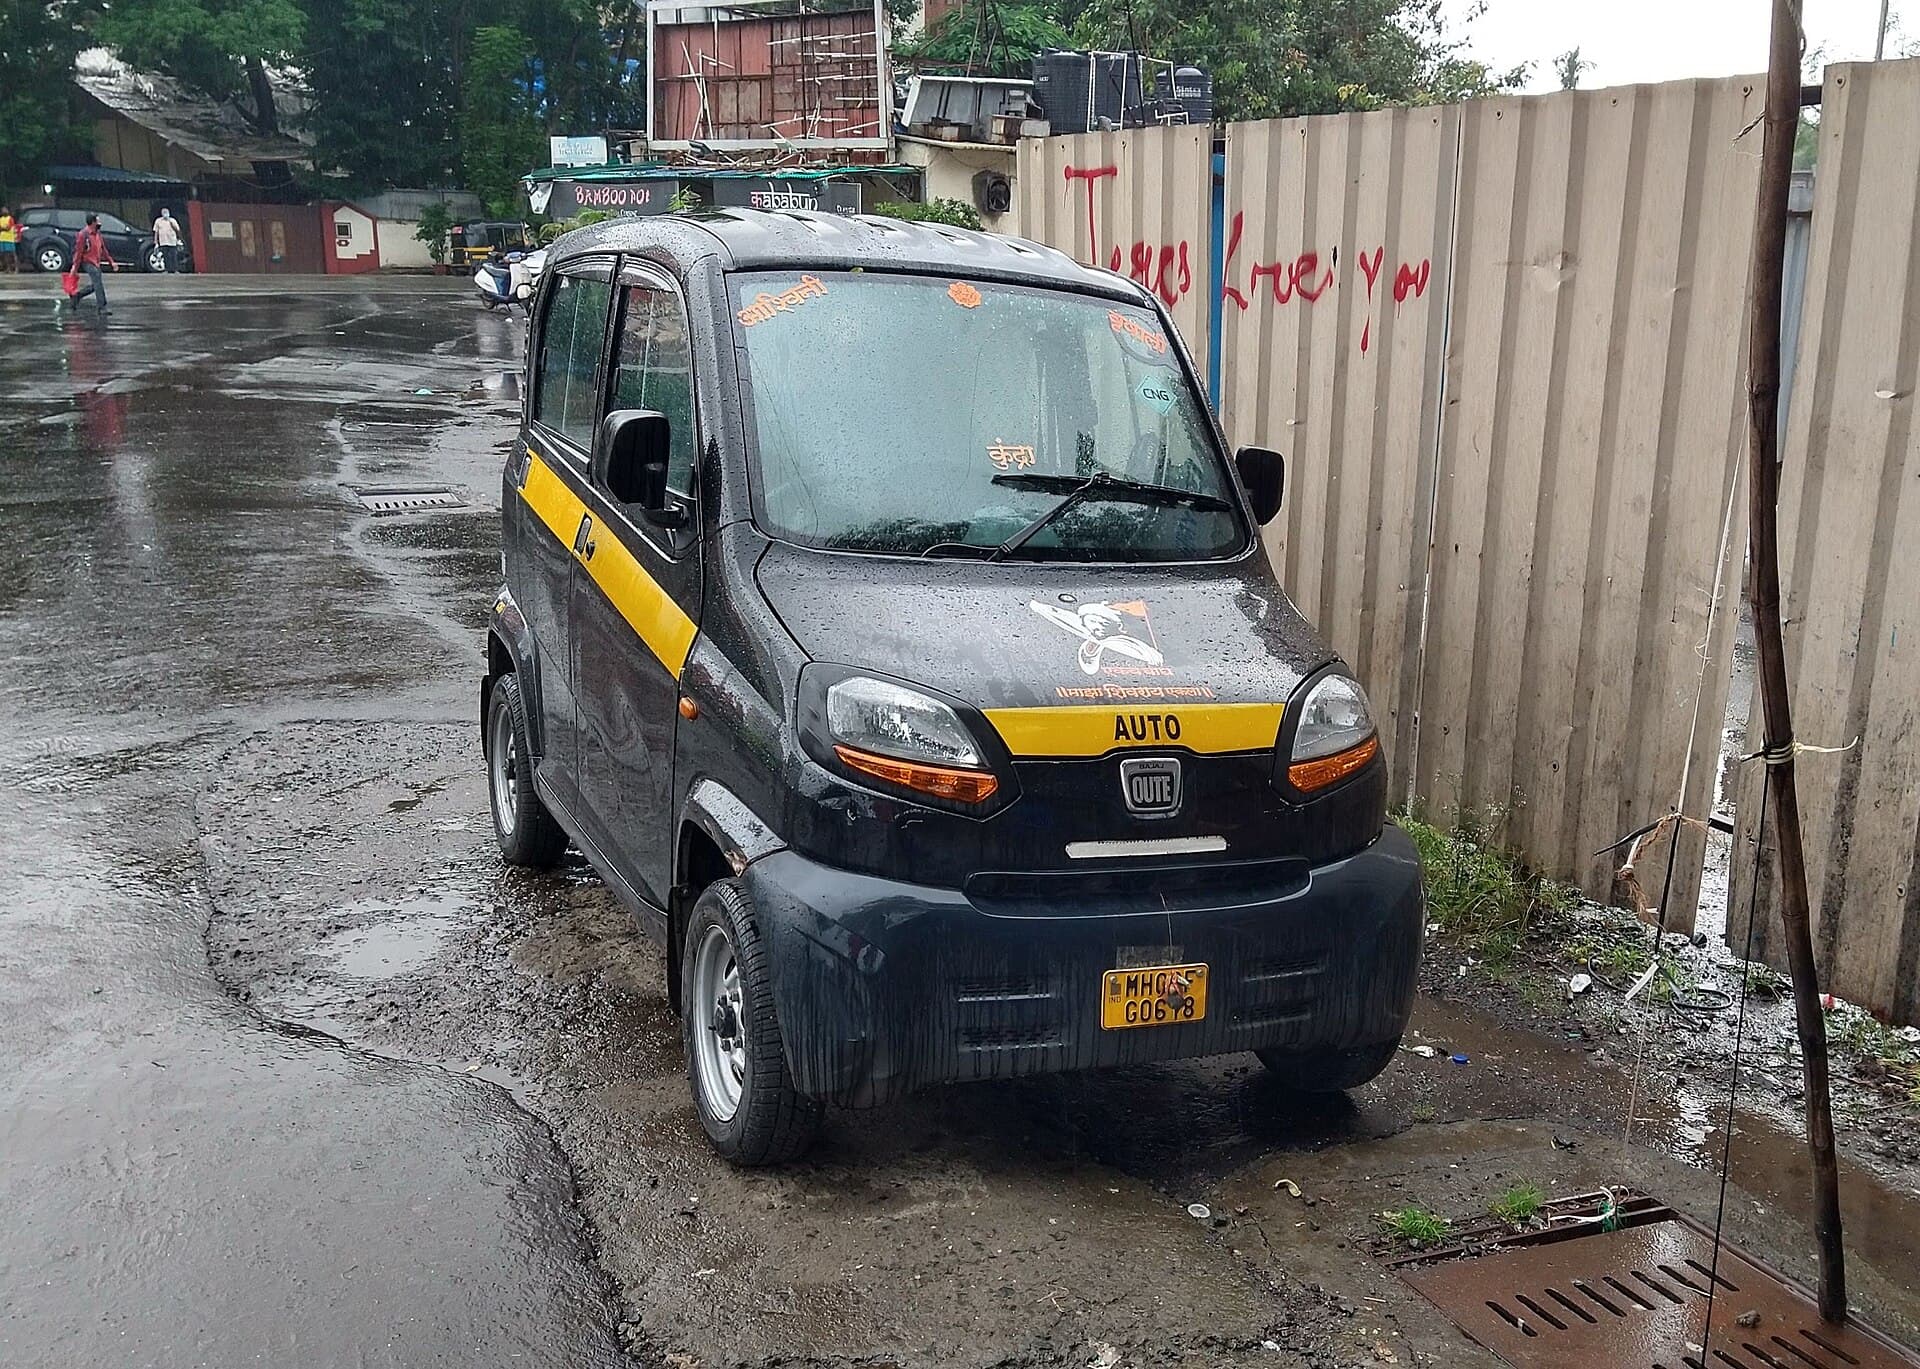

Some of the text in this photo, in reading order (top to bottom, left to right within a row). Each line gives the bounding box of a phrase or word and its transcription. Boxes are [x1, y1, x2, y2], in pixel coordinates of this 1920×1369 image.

[575, 185, 626, 206] BAMBOO
[1143, 388, 1170, 401] CNG
[1114, 714, 1181, 741] AUTO
[1139, 762, 1164, 770] BAJAJ
[1132, 775, 1171, 804] QUTE
